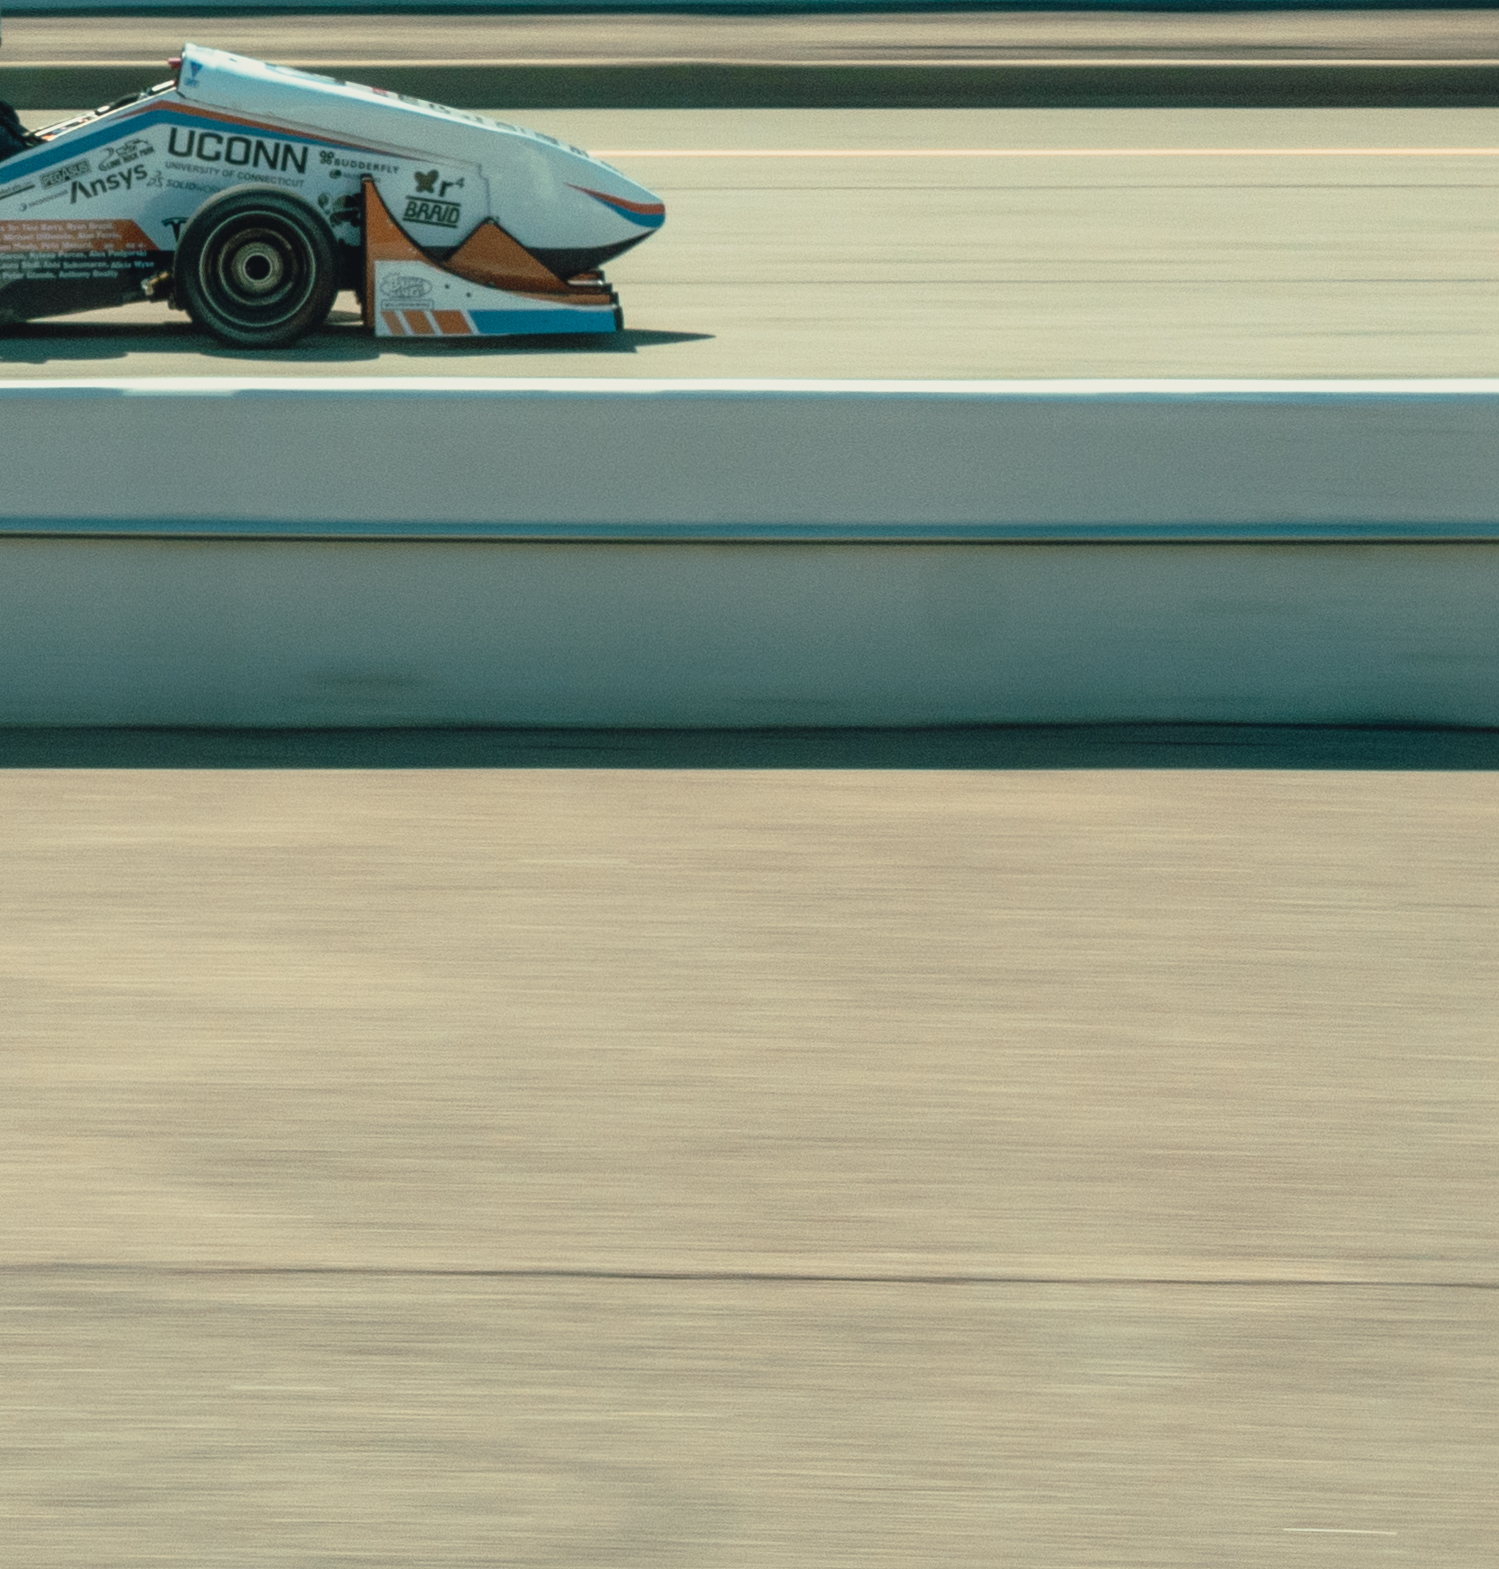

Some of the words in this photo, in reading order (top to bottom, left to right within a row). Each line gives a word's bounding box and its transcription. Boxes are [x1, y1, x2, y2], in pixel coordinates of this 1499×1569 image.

[167, 126, 308, 174] UCONN
[42, 160, 90, 188] PEGASUS
[70, 163, 148, 205] Ansys
[165, 161, 221, 176] UNIVERSITY
[222, 168, 235, 178] OF
[236, 170, 305, 188] CONNECTICUT
[404, 199, 461, 225] BRAID
